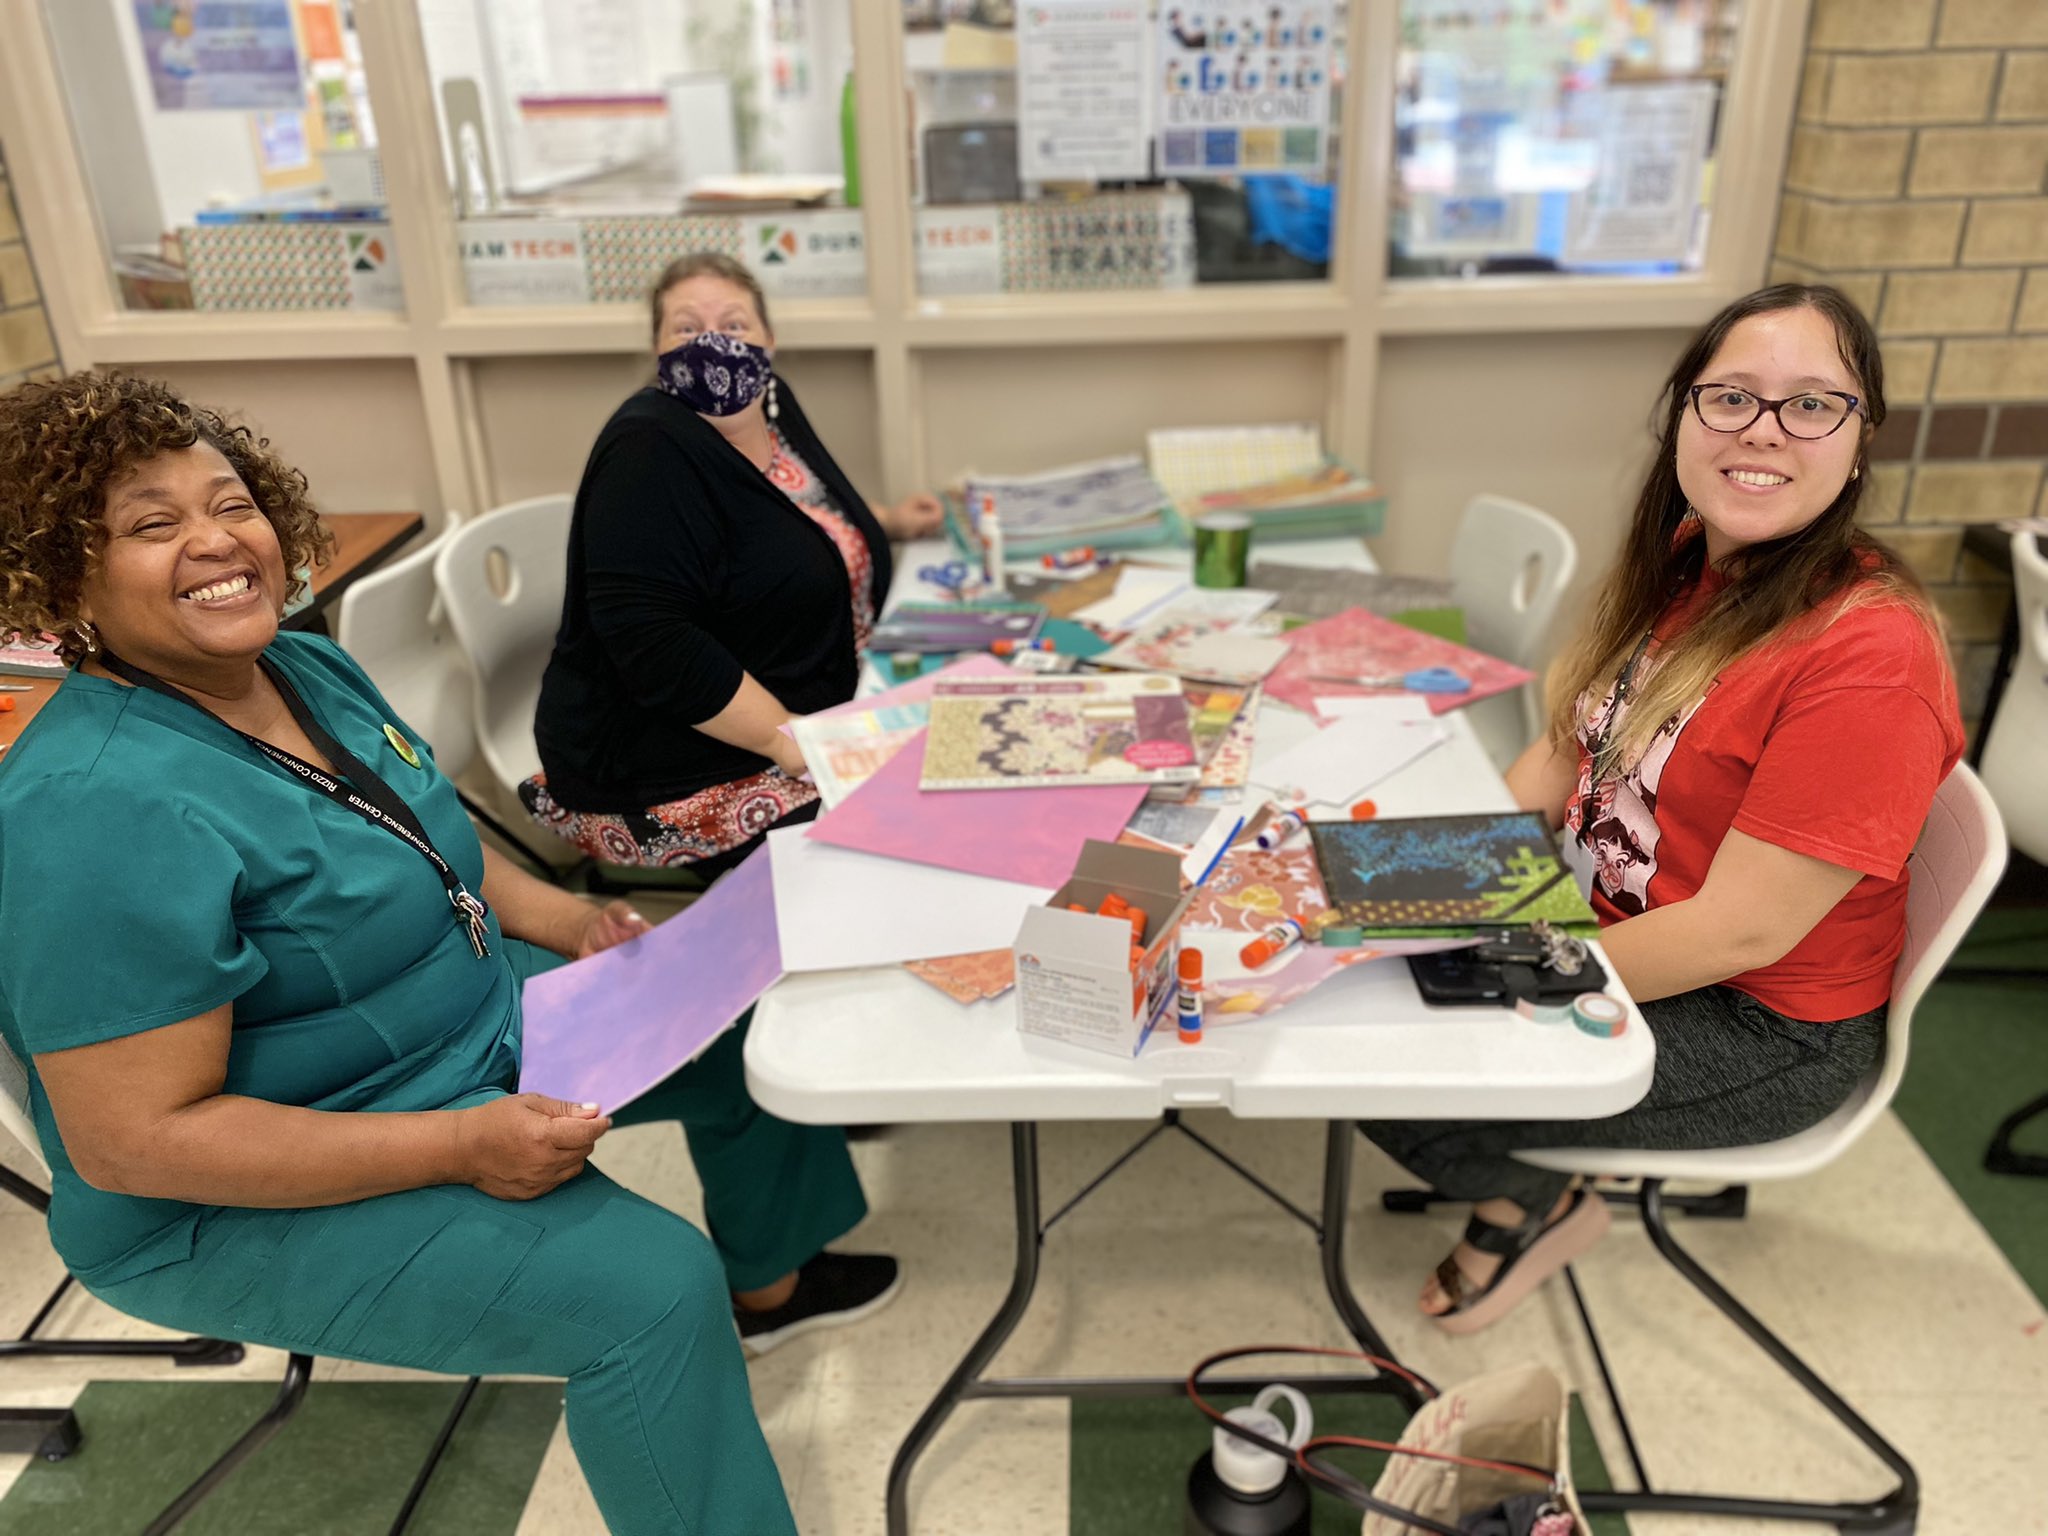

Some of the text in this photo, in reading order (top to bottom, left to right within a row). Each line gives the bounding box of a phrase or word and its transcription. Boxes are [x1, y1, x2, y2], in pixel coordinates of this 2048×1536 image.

[1168, 94, 1310, 121] EVERYONE
[927, 225, 993, 247] TECH
[510, 240, 577, 258] TECH
[310, 773, 338, 792] RIZZO
[347, 794, 382, 818] CENTER
[382, 814, 430, 854] CONFERENCE
